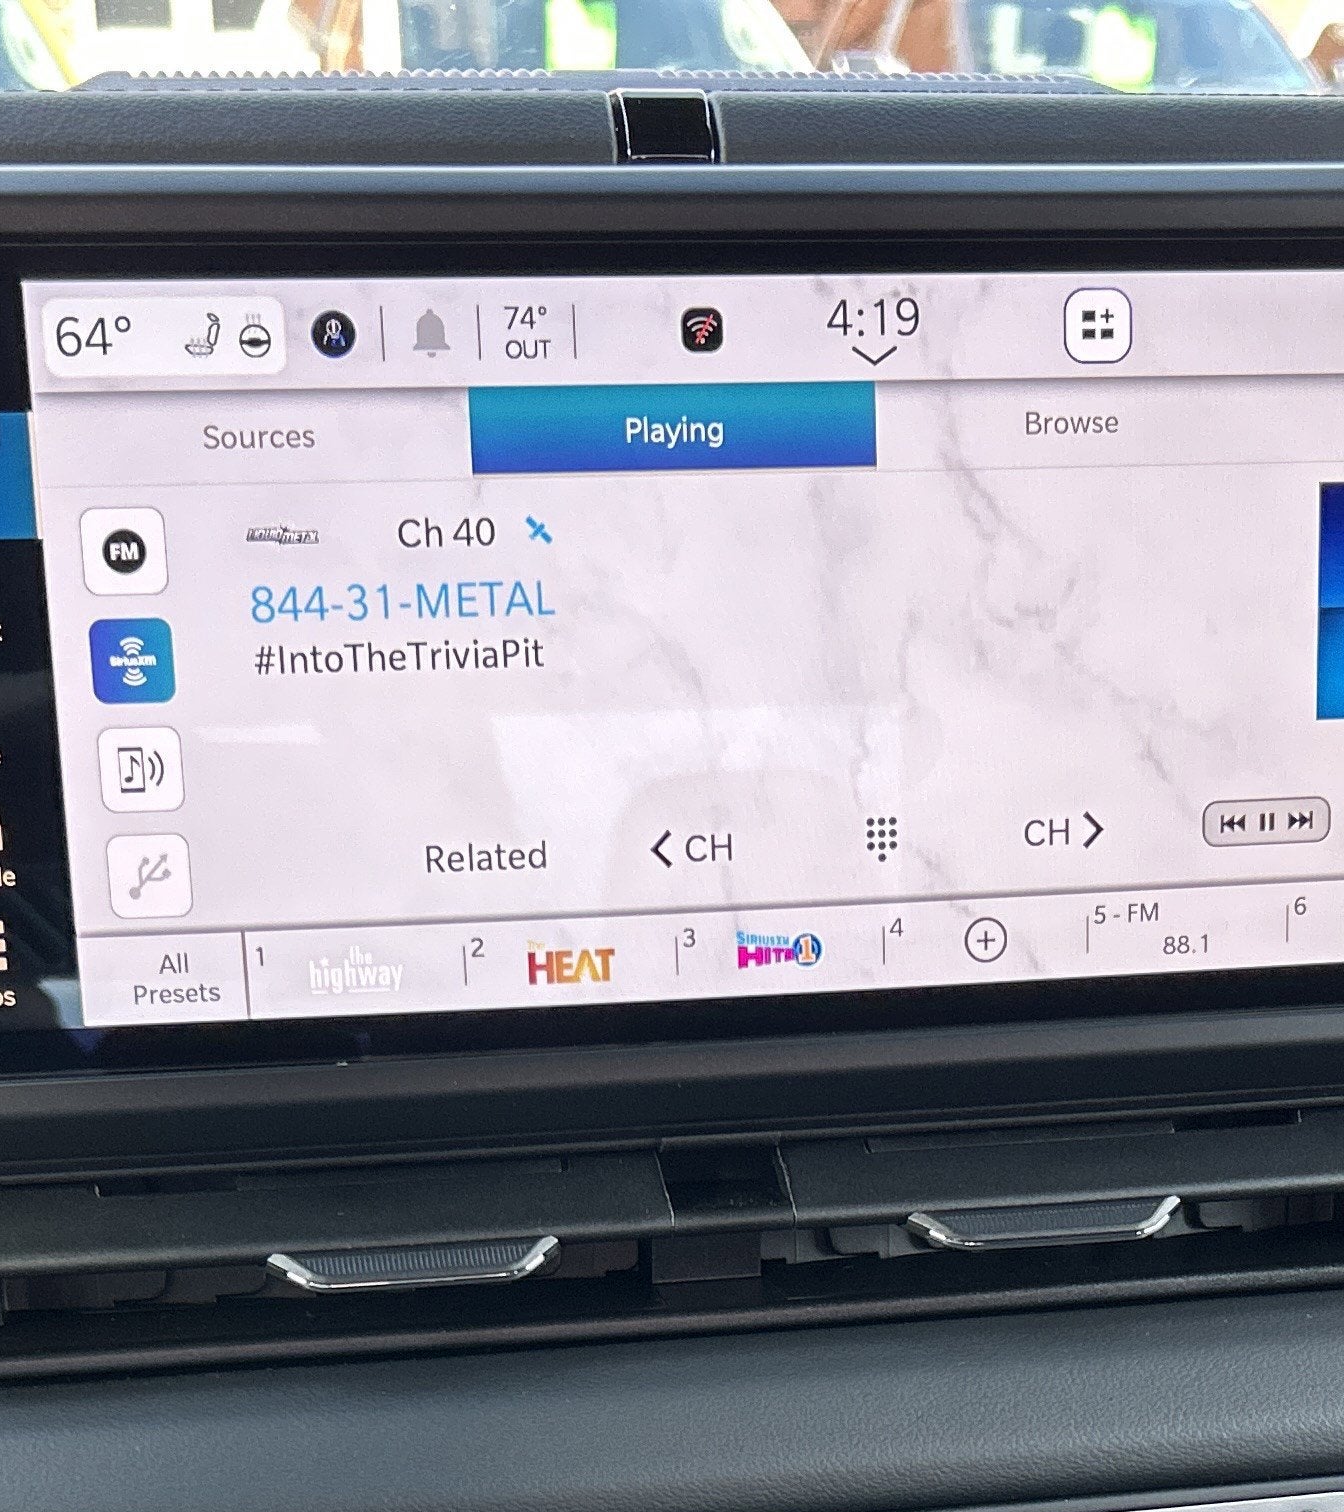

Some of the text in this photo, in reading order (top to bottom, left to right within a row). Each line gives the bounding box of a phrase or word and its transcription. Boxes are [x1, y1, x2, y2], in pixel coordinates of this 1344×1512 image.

[503, 306, 548, 330] 74°
[826, 297, 920, 337] 4:19
[55, 315, 132, 356] 64°
[505, 339, 551, 360] OUT
[625, 416, 724, 448] Playing
[1025, 411, 1119, 435] Browse
[202, 424, 316, 450] Sources
[398, 518, 495, 548] Ch 40
[110, 542, 138, 561] FM
[250, 579, 556, 624] 844-31-METAL
[255, 637, 545, 676] #IntoTheTriviaPit
[1024, 819, 1071, 846] CH
[425, 840, 548, 873] Related
[685, 833, 734, 862] CH
[1094, 907, 1107, 925] 5
[1127, 902, 1160, 922] FM
[1295, 897, 1306, 915] 6
[682, 928, 697, 948] 3
[889, 918, 904, 937] 4
[255, 947, 264, 966] 1
[471, 938, 485, 957] 2
[1162, 934, 1211, 956] 88.1
[159, 953, 189, 975] All
[308, 958, 403, 991] highway
[528, 947, 615, 985] HEAT
[133, 983, 221, 1006] Presets
